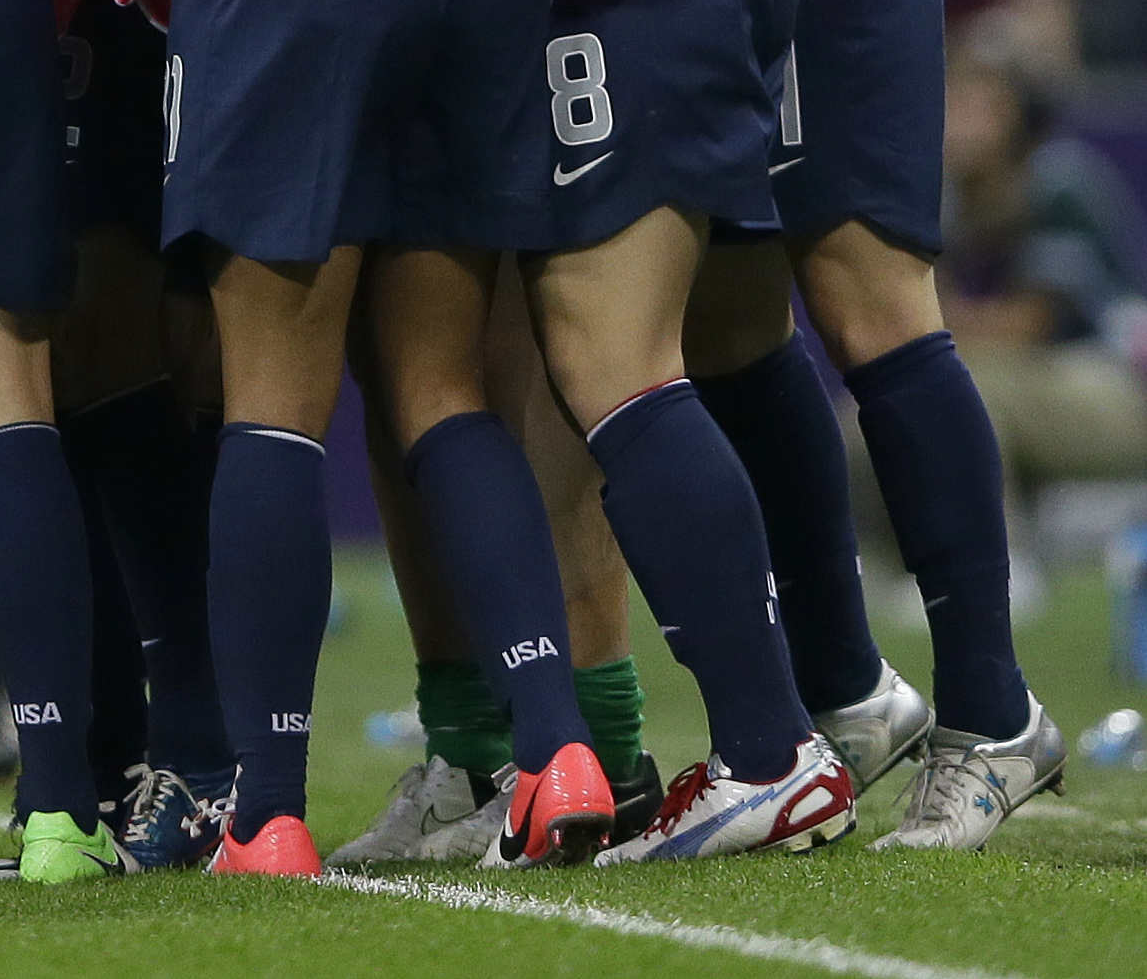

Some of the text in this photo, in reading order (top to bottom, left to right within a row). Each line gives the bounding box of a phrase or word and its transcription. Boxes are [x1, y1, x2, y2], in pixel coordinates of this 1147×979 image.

[546, 32, 613, 146] 8
[502, 636, 558, 669] USA
[13, 701, 62, 724] USA
